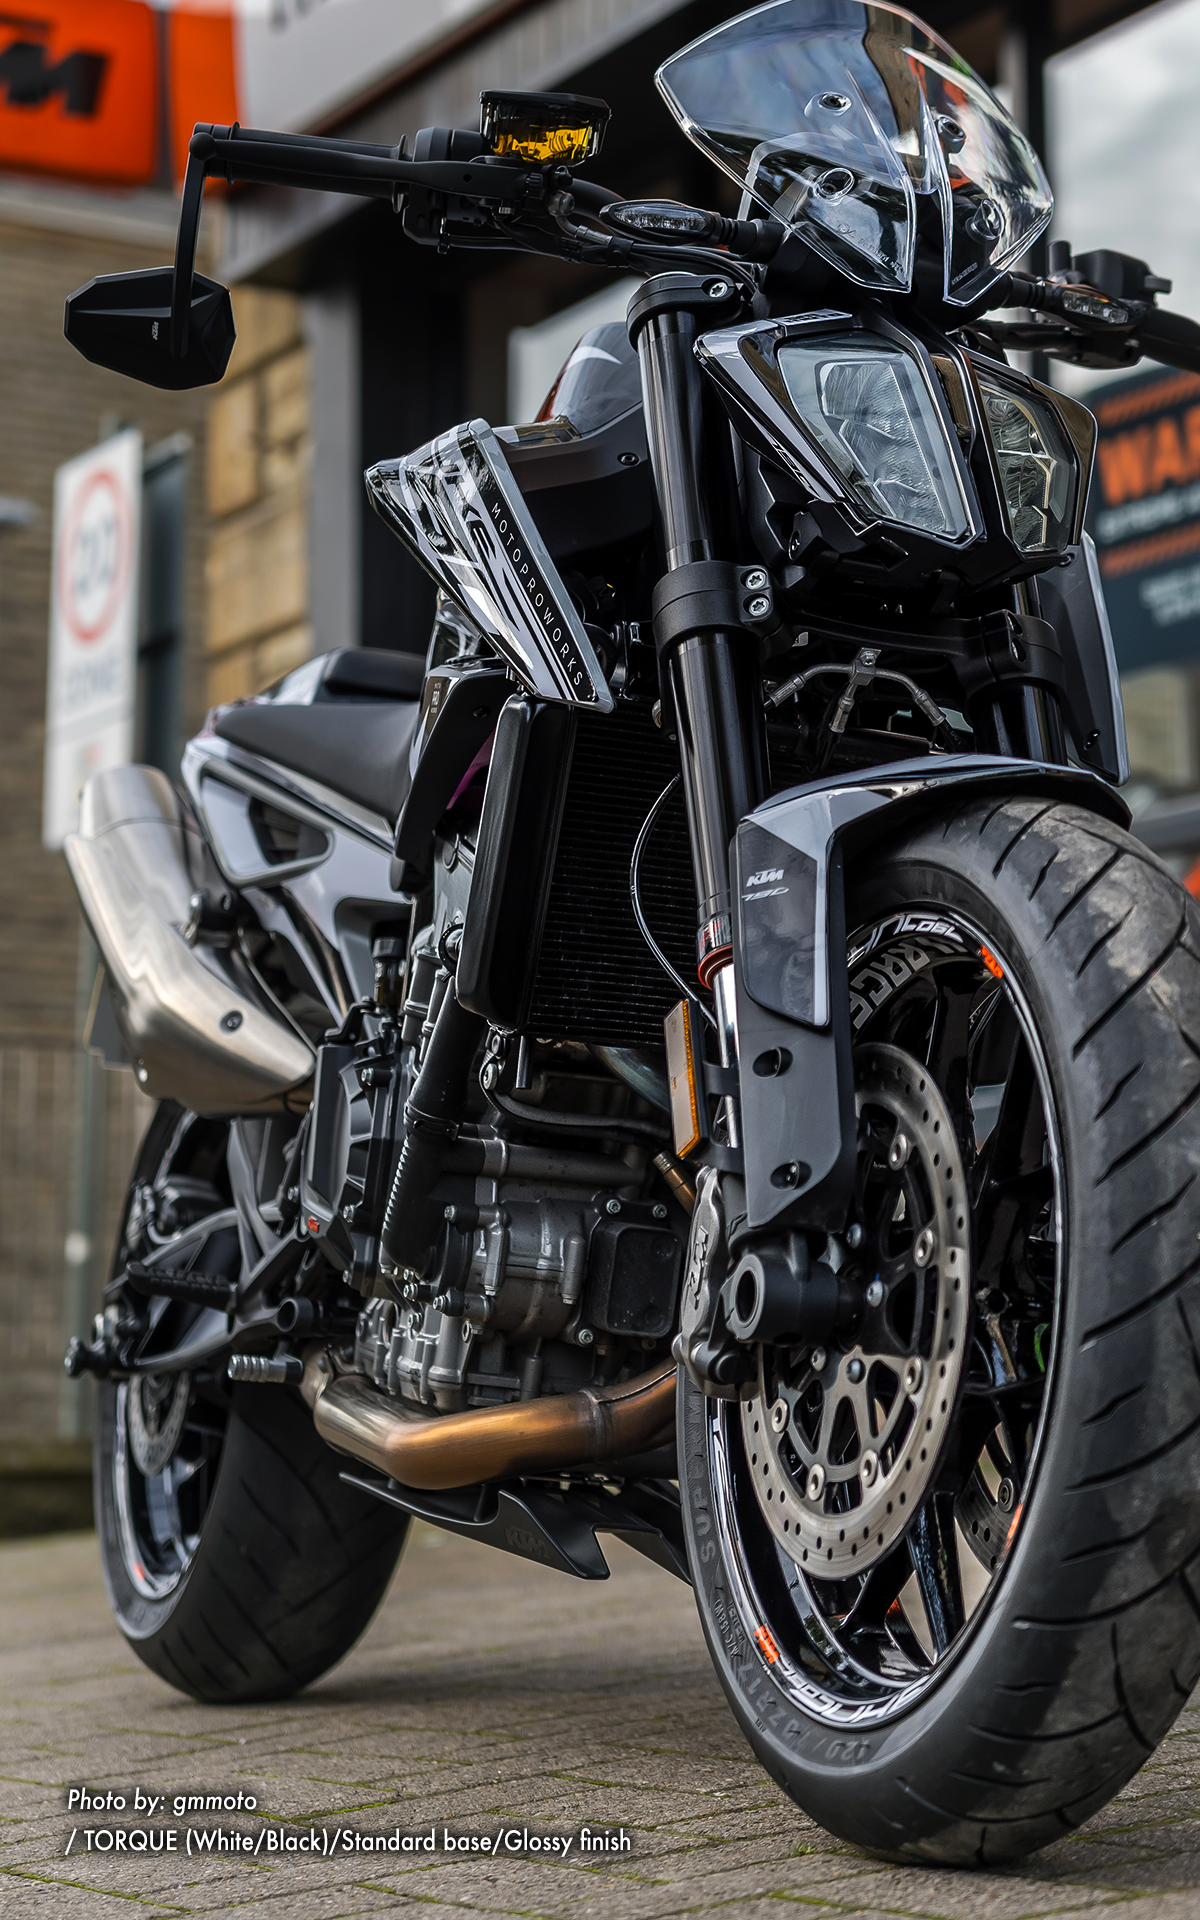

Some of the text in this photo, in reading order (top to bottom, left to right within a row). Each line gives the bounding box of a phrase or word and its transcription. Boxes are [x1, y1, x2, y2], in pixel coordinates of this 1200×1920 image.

[491, 502, 583, 686] MOTOPROWORKS
[741, 886, 790, 902] 790
[746, 868, 785, 888] KTM
[685, 1394, 716, 1563] SUPERM
